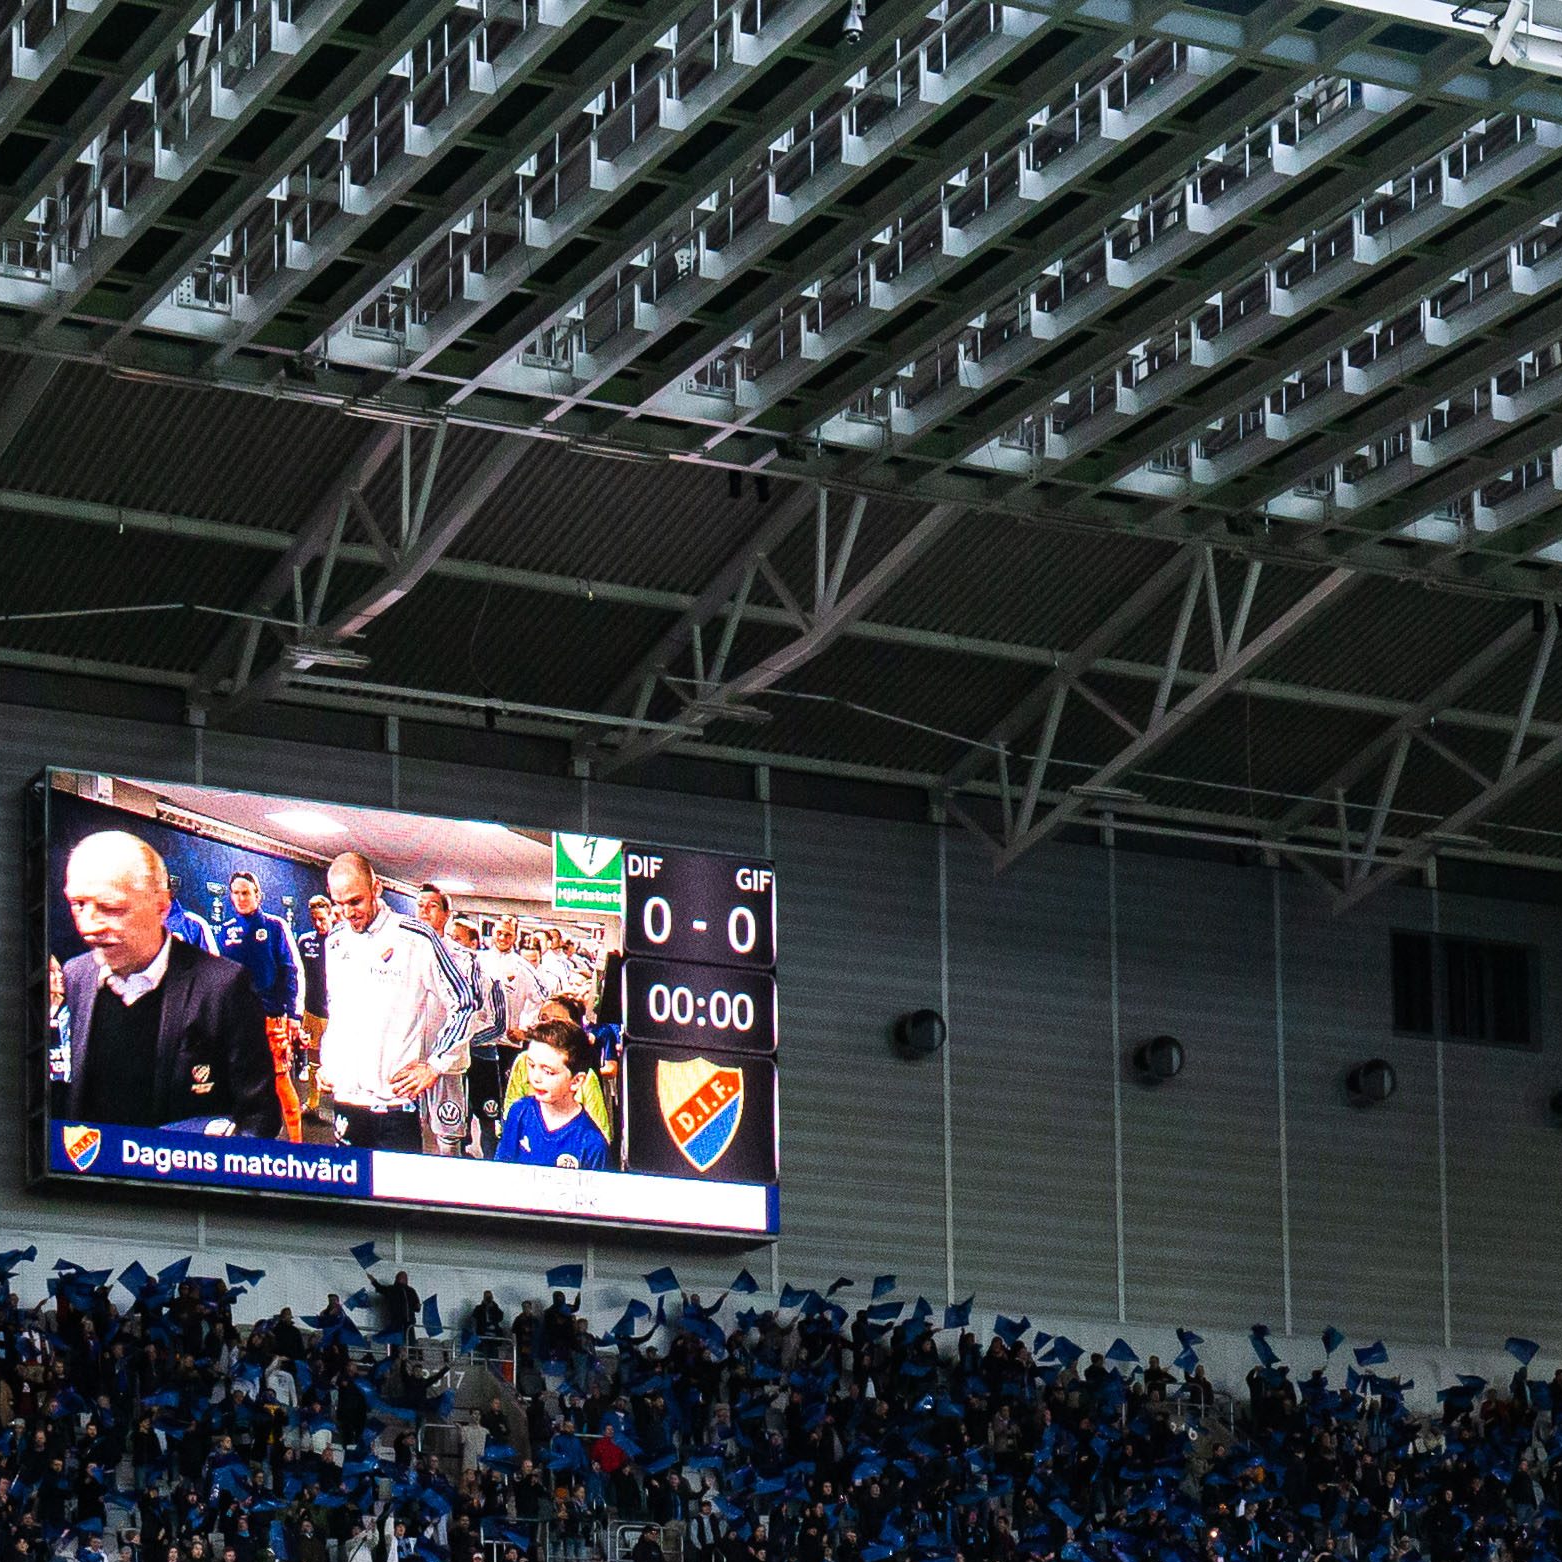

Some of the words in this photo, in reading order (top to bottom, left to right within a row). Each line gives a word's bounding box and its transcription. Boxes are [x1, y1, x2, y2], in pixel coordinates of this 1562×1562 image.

[628, 854, 663, 878] DIF
[736, 868, 772, 892] GIF
[643, 896, 671, 944] 0
[728, 906, 756, 954] 0
[649, 983, 754, 1032] 00:00
[121, 1139, 218, 1173] Dagens
[224, 1152, 358, 1184] matchvärd
